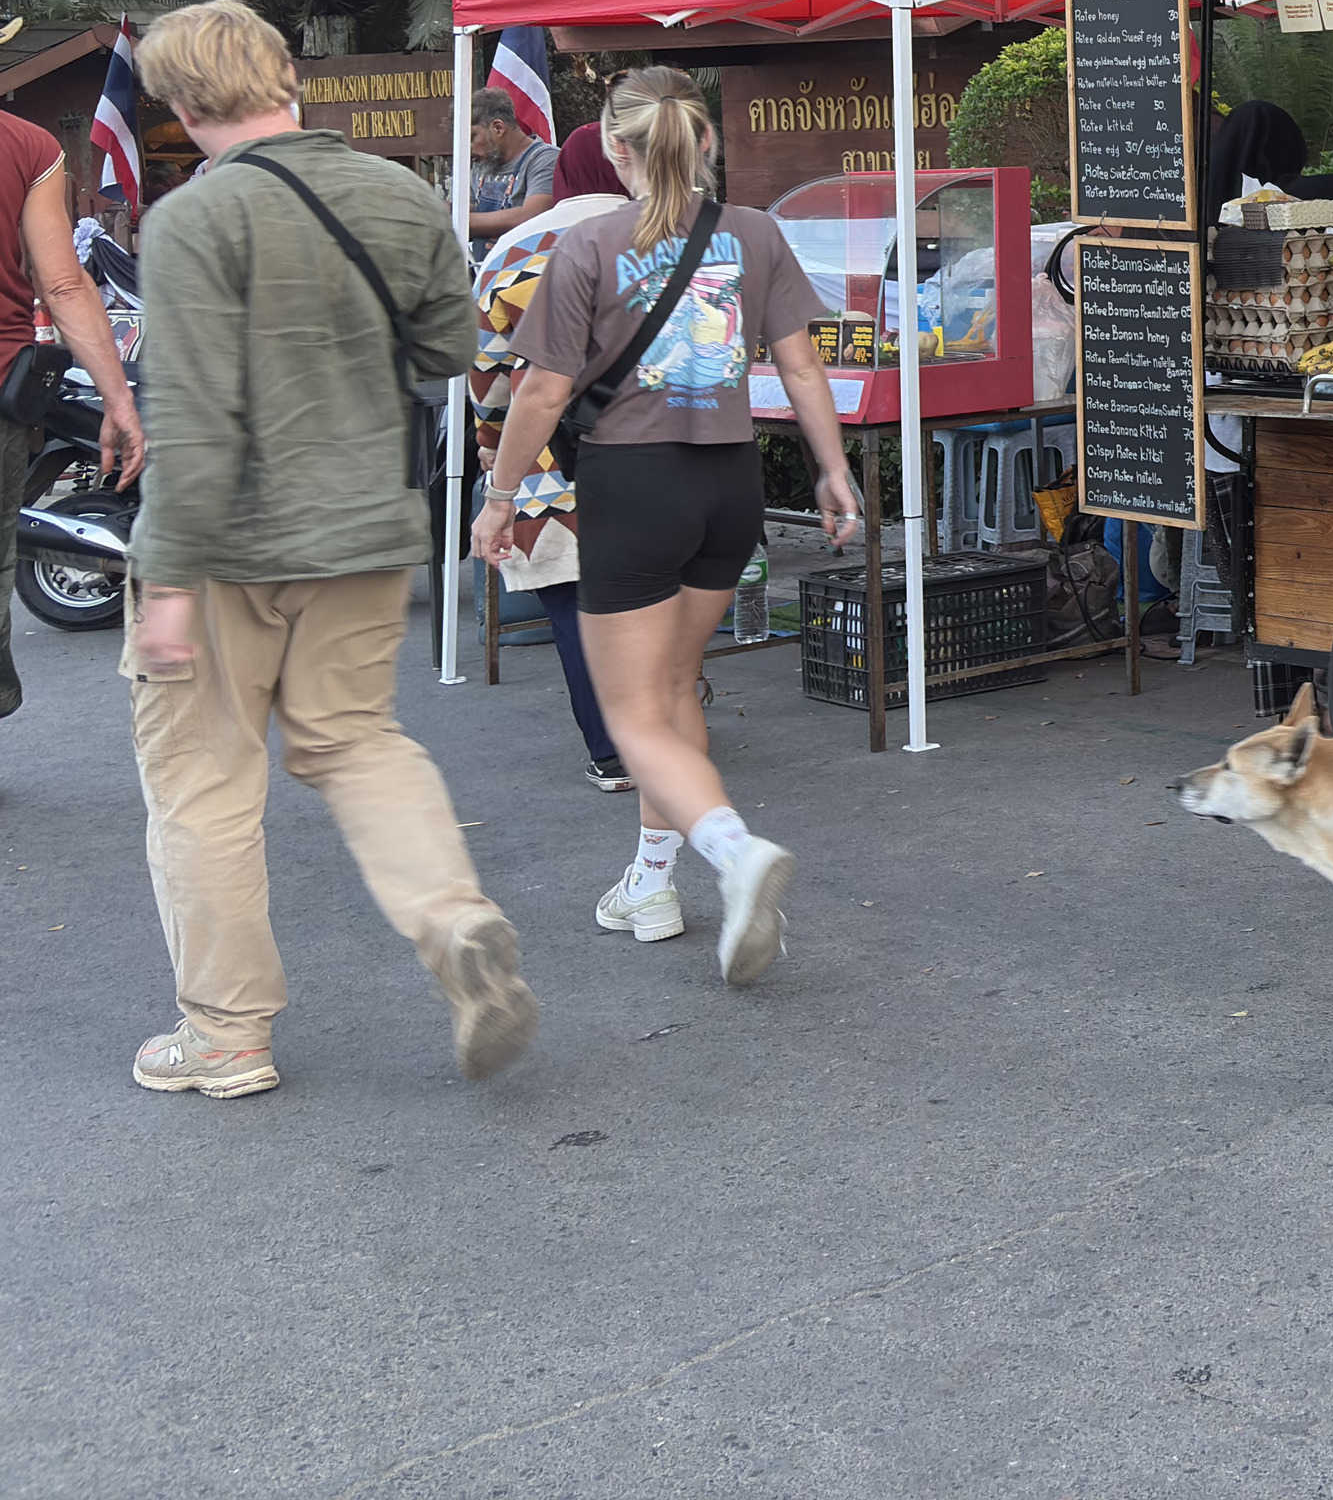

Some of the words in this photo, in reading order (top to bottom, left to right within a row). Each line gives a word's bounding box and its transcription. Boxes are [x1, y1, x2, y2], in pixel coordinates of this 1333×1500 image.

[1075, 9, 1096, 21] Rotee
[1098, 8, 1119, 24] honey
[1075, 31, 1093, 44] Rotee
[1146, 33, 1162, 48] egg
[1076, 57, 1092, 67] Rotee
[1132, 55, 1147, 70] egg
[303, 75, 368, 103] MAEHONGSON
[371, 72, 428, 100] PROVINCIAL
[430, 70, 454, 97] COU
[1079, 97, 1101, 111] Rotee
[352, 111, 370, 138] PAI
[371, 109, 415, 138] BRANCH
[1080, 118, 1103, 132] Rotee
[1080, 141, 1102, 154] Rotee
[1105, 144, 1120, 157] egg
[1085, 164, 1108, 180] Rotee
[1085, 185, 1107, 198] Rotee
[1108, 185, 1139, 198] Banana
[1083, 250, 1110, 269] Rotee
[1167, 263, 1182, 275] milk
[1083, 275, 1110, 292] Rotee
[1111, 278, 1142, 294] Banana
[1144, 278, 1174, 297] nutella
[1083, 301, 1107, 316] Rotee
[1107, 302, 1140, 318] Banana
[1140, 304, 1162, 318] Peanut
[1162, 305, 1180, 319] butter
[1084, 325, 1110, 340] Rotee
[1112, 324, 1144, 341] Banana
[1146, 326, 1170, 348] honey
[1085, 350, 1106, 363] Rotee
[1108, 350, 1130, 365] Peanut
[1153, 356, 1176, 368] nutella
[1085, 373, 1111, 389] Rotee
[1166, 368, 1191, 378] Banana
[1086, 397, 1109, 410] Rotee
[1110, 399, 1138, 414] Banana
[1087, 420, 1109, 433] Rotee
[1109, 420, 1139, 437] Banana
[1087, 444, 1114, 462] Crispy
[1116, 444, 1138, 460] Rotee
[1087, 466, 1113, 482] Crispy
[1114, 469, 1134, 482] Rotee
[1087, 489, 1112, 505] Crispy
[1112, 491, 1131, 506] Rotee
[1132, 493, 1155, 508] nutella
[169, 1042, 184, 1066] N
